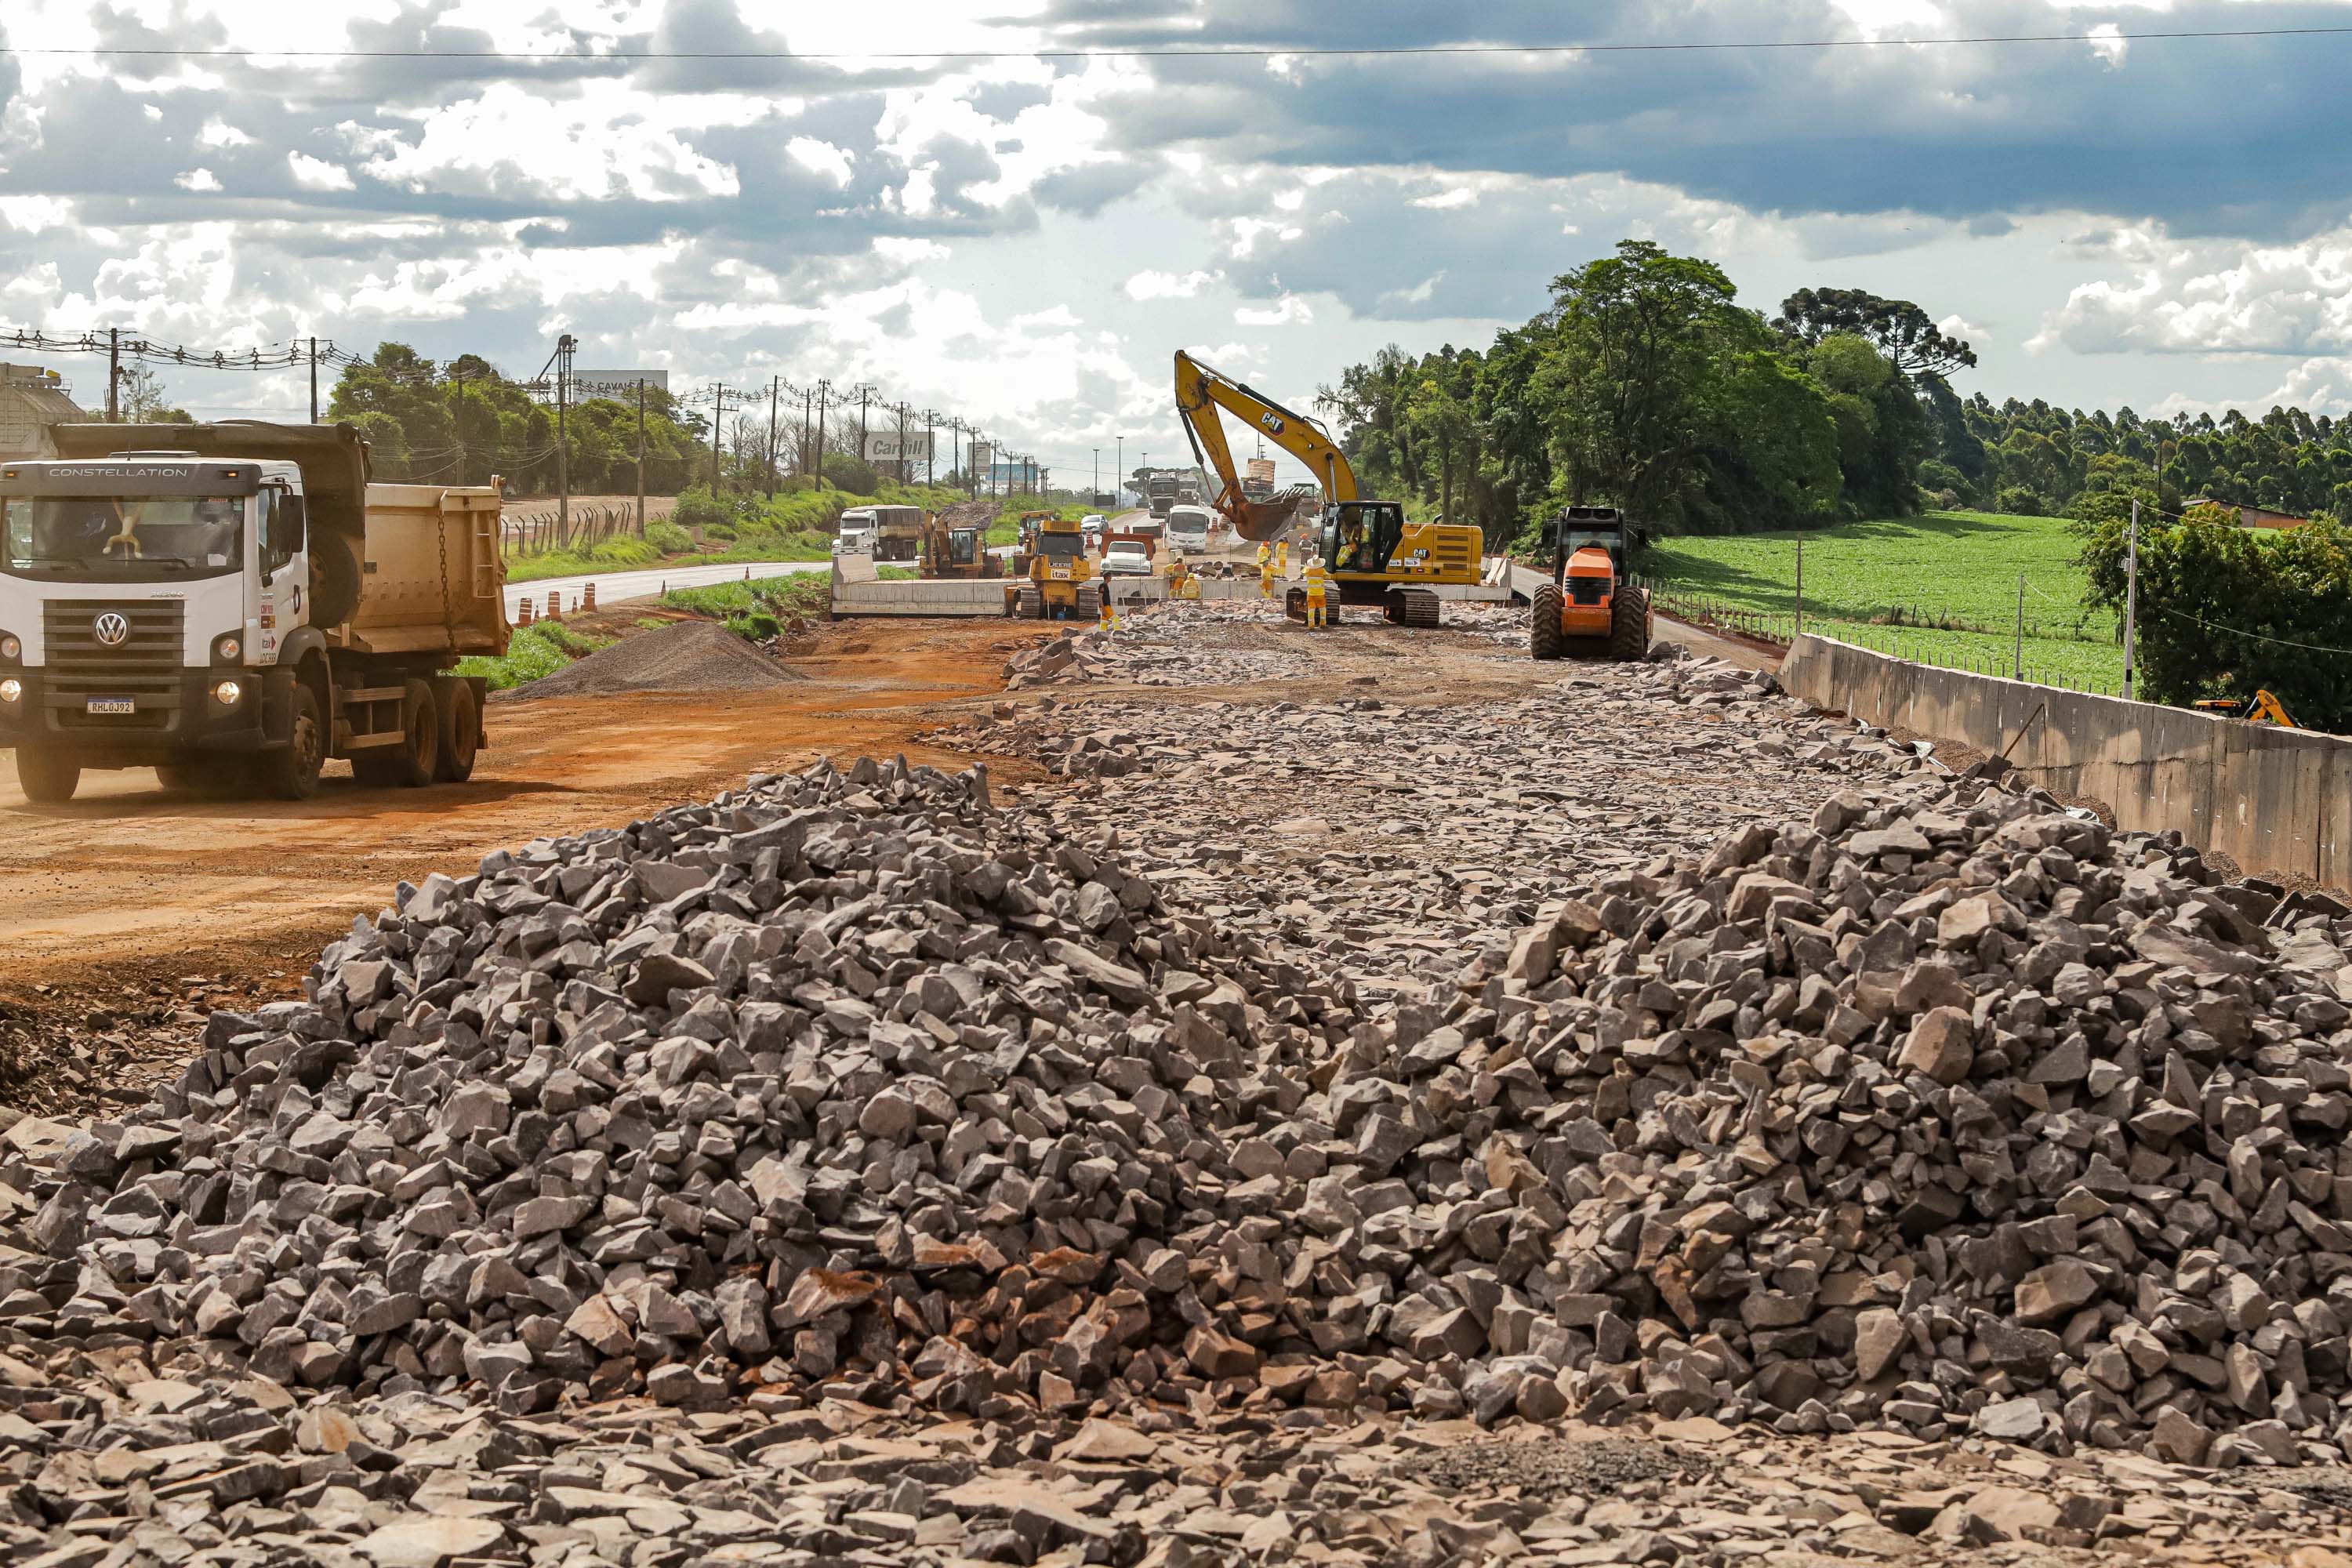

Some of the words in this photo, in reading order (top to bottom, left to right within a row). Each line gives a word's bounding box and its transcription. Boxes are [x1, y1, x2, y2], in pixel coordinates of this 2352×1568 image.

[1261, 412, 1283, 431] CAT
[49, 468, 188, 477] CONSTELLATION
[1414, 549, 1427, 558] CAT
[1052, 570, 1069, 579] itax
